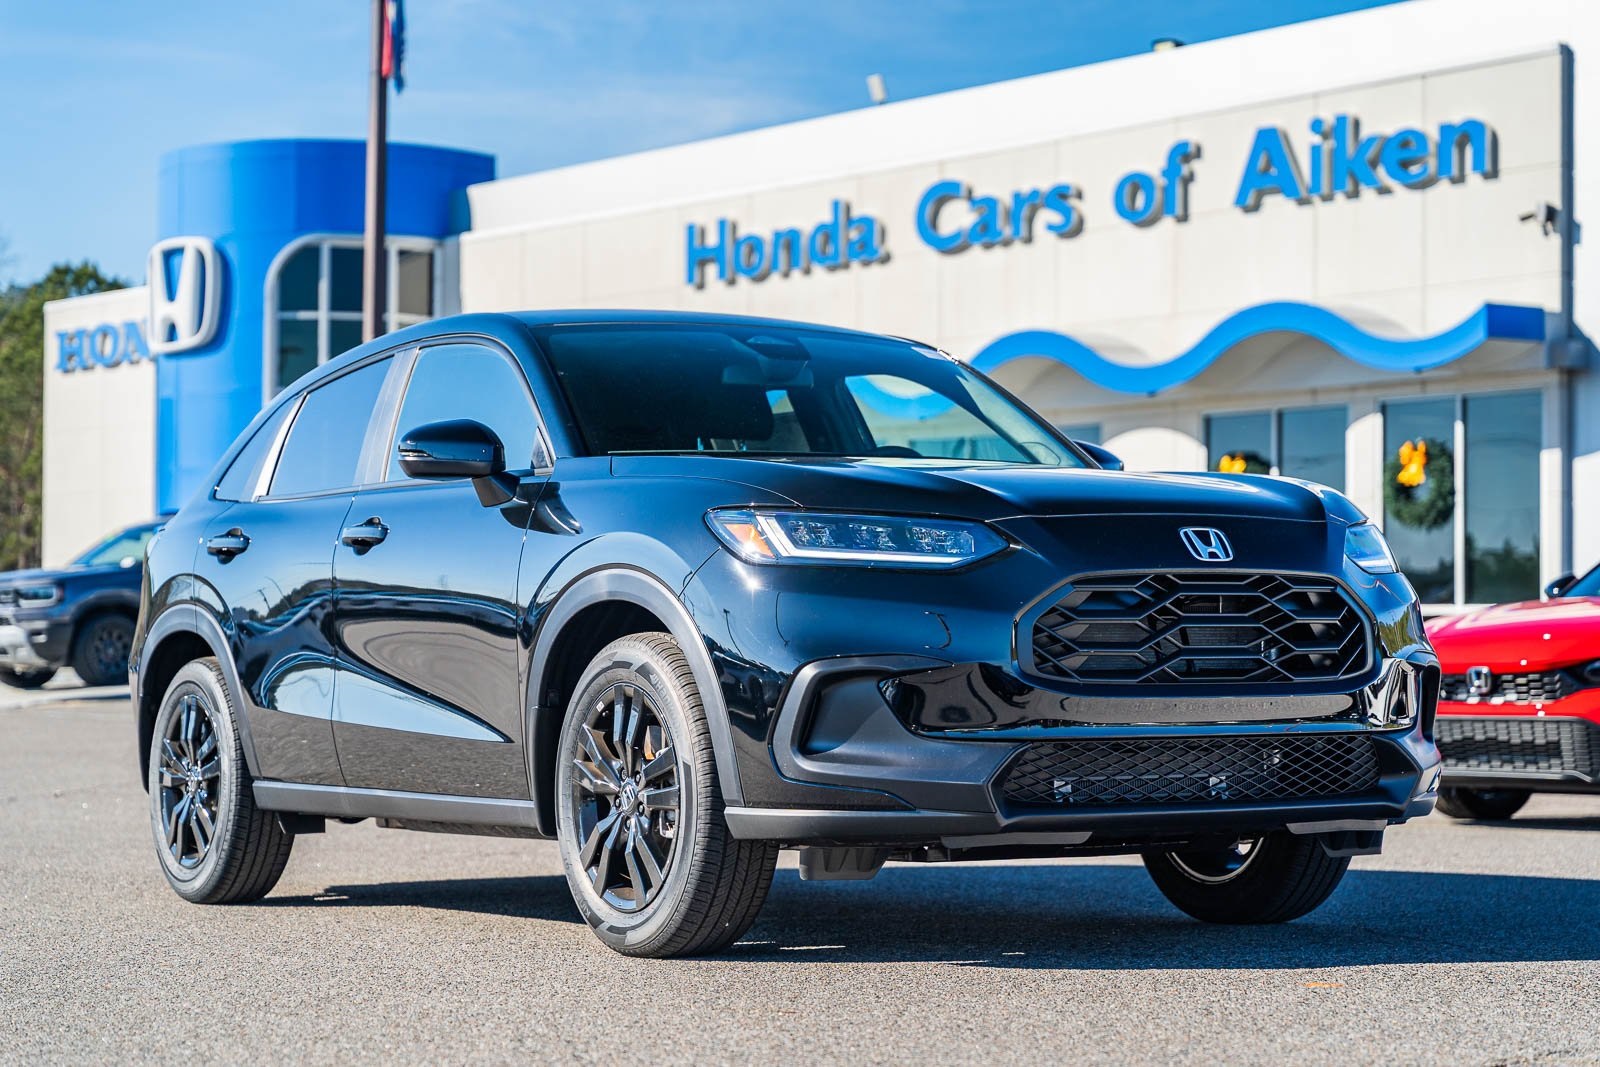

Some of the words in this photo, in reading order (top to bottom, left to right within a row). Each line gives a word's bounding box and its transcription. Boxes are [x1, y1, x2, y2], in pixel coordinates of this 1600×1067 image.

[685, 199, 889, 288] Honda
[916, 178, 1083, 253] Cars
[1114, 140, 1201, 225] of
[1234, 113, 1498, 211] Aiken
